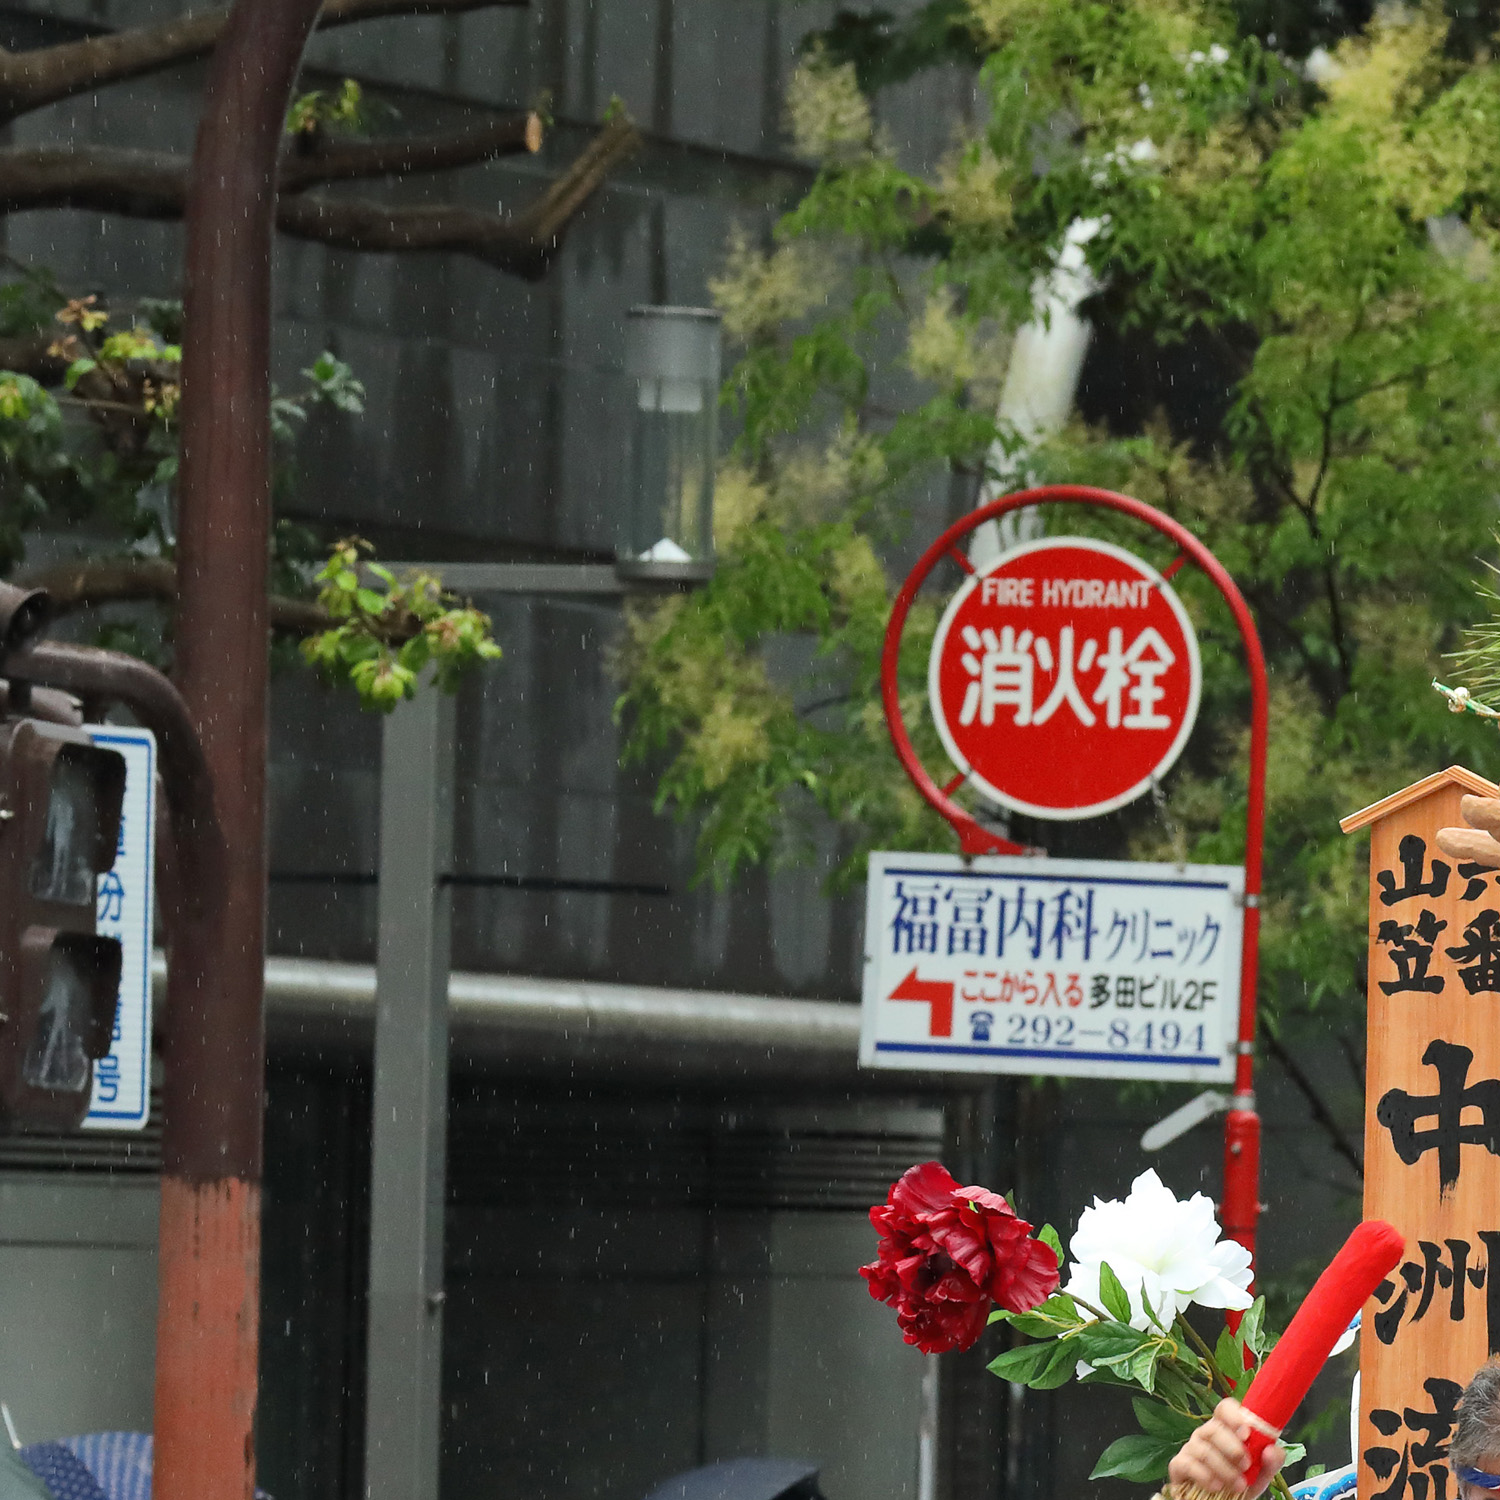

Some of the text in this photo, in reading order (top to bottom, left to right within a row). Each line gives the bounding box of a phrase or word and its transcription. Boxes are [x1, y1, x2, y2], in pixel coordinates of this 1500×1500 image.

[981, 577, 1151, 609] FIRE HYDRANT
[958, 624, 1176, 730] 消火栓
[1105, 908, 1221, 966] クリニック
[1375, 834, 1452, 997] 山笠
[961, 968, 1084, 1008] ここから入る
